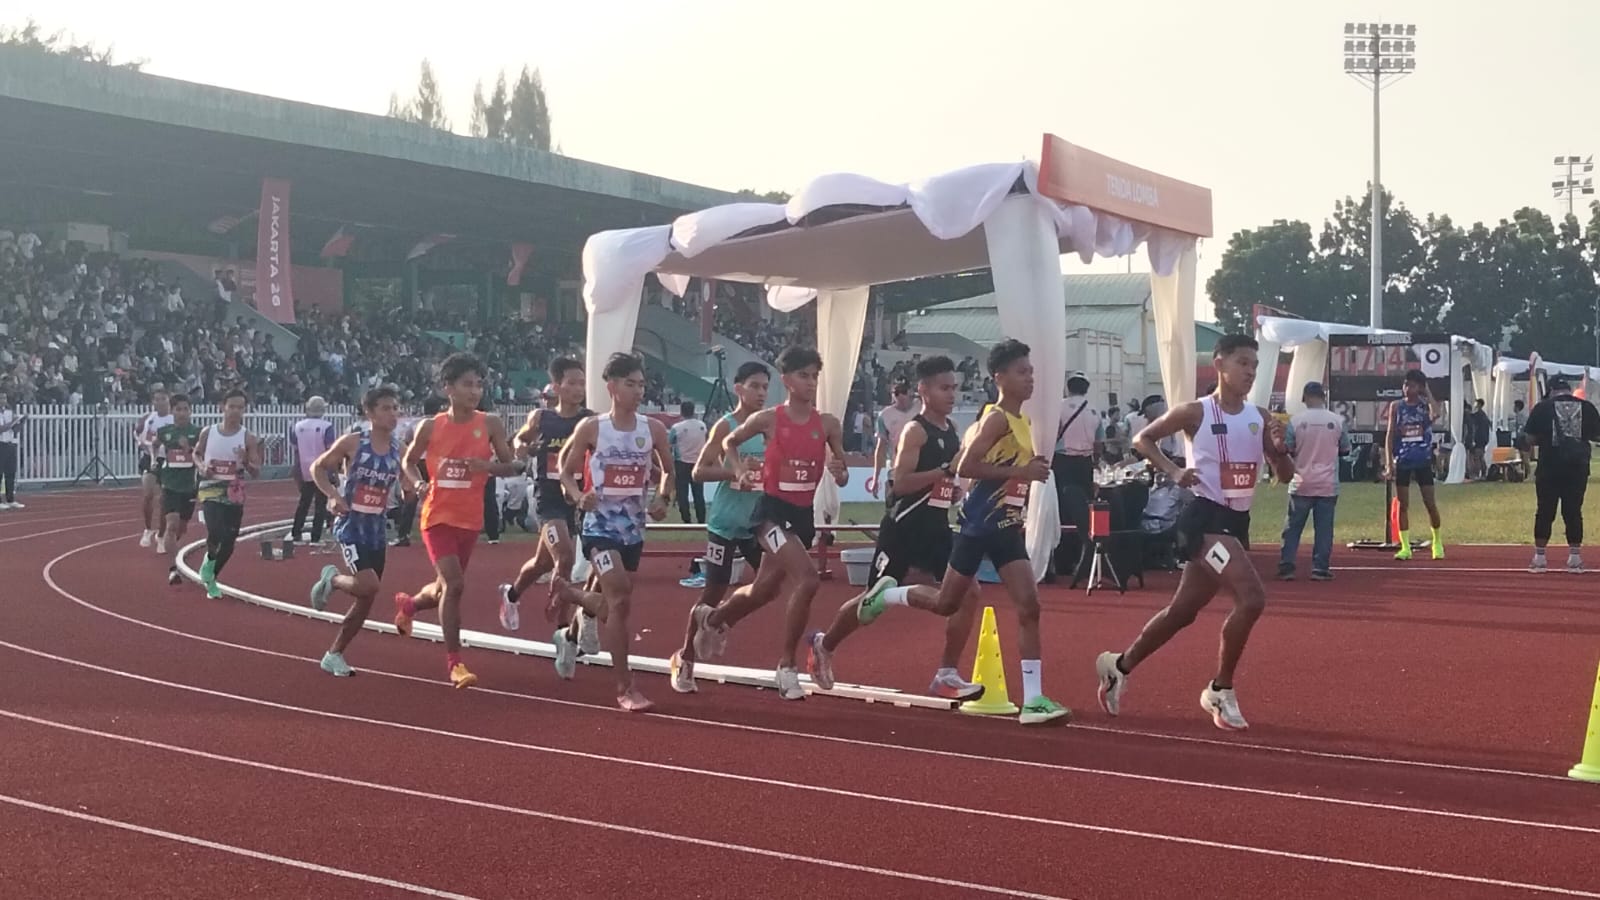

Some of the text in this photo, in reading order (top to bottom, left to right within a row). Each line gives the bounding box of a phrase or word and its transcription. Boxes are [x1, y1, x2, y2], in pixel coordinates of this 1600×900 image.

[270, 196, 280, 278] JAKARTA
[446, 467, 466, 478] 237
[613, 475, 635, 485] 492
[1233, 474, 1250, 486] 102
[547, 530, 555, 544] 6
[768, 530, 779, 548] 7
[345, 548, 352, 562] 9
[709, 547, 722, 561] 15
[1211, 550, 1224, 564] 1
[597, 554, 610, 570] 14
